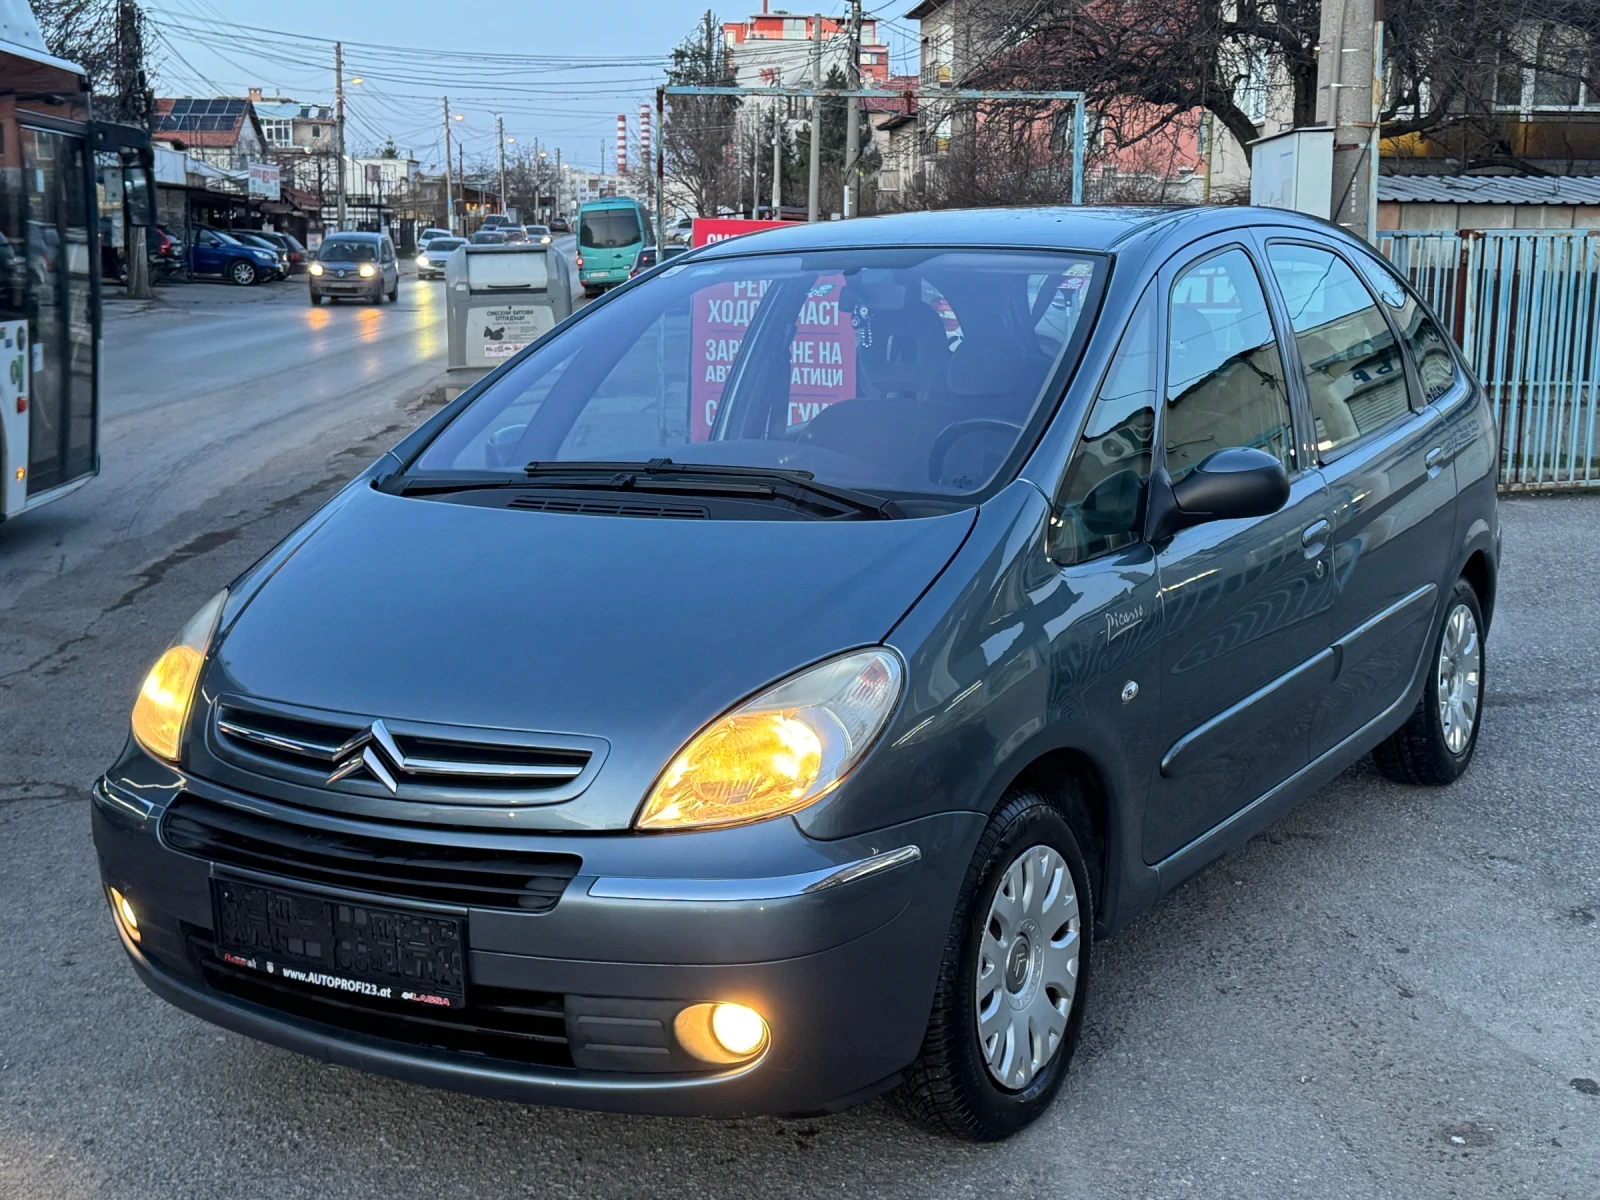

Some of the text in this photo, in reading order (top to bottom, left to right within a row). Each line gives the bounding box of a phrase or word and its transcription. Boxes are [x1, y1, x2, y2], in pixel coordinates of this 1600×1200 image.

[708, 299, 761, 328] ХОД
[819, 341, 843, 364] НА
[787, 402, 833, 427] ГУМ
[1105, 604, 1144, 646] Picasso
[282, 967, 392, 998] www.AUTOPROFI23.at
